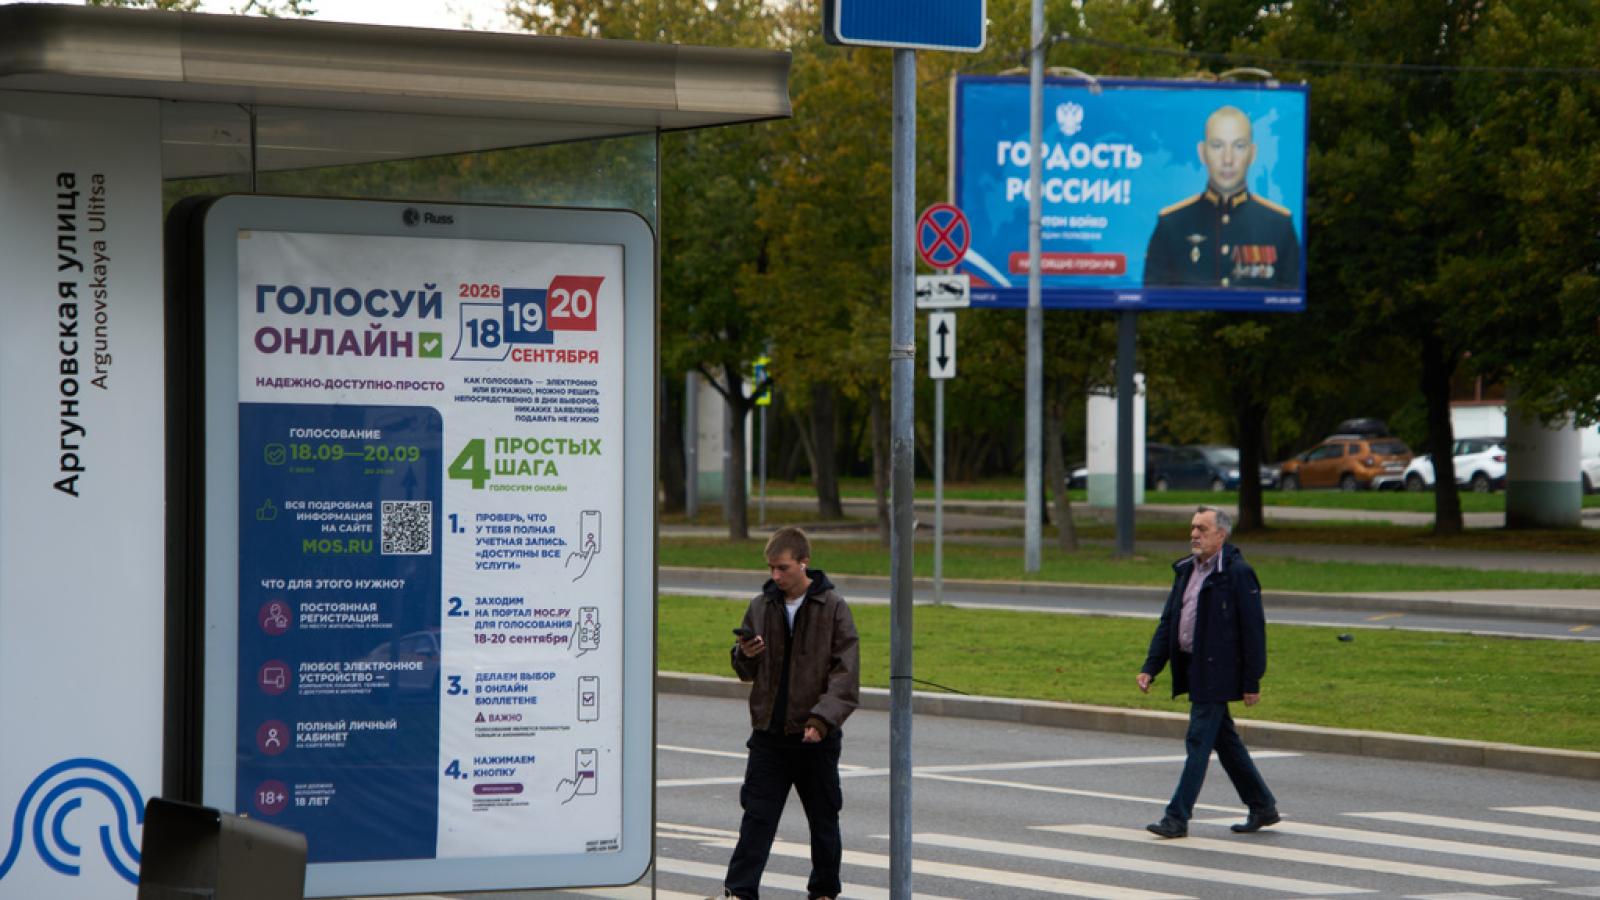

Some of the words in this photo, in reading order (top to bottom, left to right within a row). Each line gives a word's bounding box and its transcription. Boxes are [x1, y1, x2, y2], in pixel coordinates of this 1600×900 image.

[88, 173, 107, 233] Ulitsa
[57, 171, 84, 272] улица
[424, 211, 454, 225] Russ
[459, 283, 500, 299] 2026
[256, 283, 443, 319] ГОЛОСУЙ
[551, 288, 593, 318] 20
[89, 240, 112, 390] Argunovskaya
[508, 303, 543, 332] 19
[466, 318, 501, 348] 18
[254, 323, 413, 358] ОНЛАЙН
[511, 348, 599, 364] СЕНТЯБРЯ
[464, 377, 480, 385] КАК
[482, 377, 533, 385] ГОЛОСОВАТЬ
[54, 282, 86, 498] Аргуновская
[491, 387, 534, 395] БУМАЖНО,
[567, 388, 599, 396] РЕШИТЬ
[454, 395, 533, 404] НЕПОСРЕДСТВЕННО
[559, 397, 599, 406] ВЫБОРОВ,
[514, 405, 551, 413] НИКАКИХ
[554, 405, 599, 414] ЗАЯВЛЕНИЙ
[515, 415, 556, 423] ПОДАВАТЬ
[558, 415, 568, 423] НЕ
[570, 416, 599, 424] НУЖНО
[290, 428, 381, 440] ГОЛОСОВАНИЕ
[495, 437, 602, 455] ПРОСТЫХ
[447, 438, 491, 490] 4
[494, 459, 558, 476] ШАГА
[489, 484, 533, 492] ГОЛОСУЕМ
[534, 484, 567, 492] ОНЛАЙН
[285, 501, 305, 510] ВСЯ
[308, 501, 373, 511] ПОДРОБНАЯ
[297, 512, 373, 523] ИНФОРМАЦИЯ
[448, 513, 465, 533] 1.
[475, 513, 525, 523] ПРОВЕРЬ,
[527, 514, 547, 522] ЧТО
[322, 524, 337, 533] НА
[339, 522, 373, 533] САЙТЕ
[475, 526, 482, 534] У
[486, 526, 512, 534] ТЕБЯ
[513, 526, 555, 534] ПОЛНАЯ
[303, 539, 373, 554] MOS.RU
[475, 538, 523, 546] УЧЕТНАЯ
[525, 538, 567, 546] ЗАПИСЬ.
[475, 550, 539, 559] «ДОСТУПНЫ
[542, 550, 561, 558] ВСЕ
[475, 562, 521, 570] УСЛУГИ»
[261, 580, 285, 589] ЧТО
[287, 580, 312, 590] ДЛЯ
[315, 580, 353, 589] ЭТОГО
[356, 580, 405, 590] НУЖНО?
[448, 597, 469, 617] 2.
[475, 597, 524, 606] ЗАХОДИМ
[300, 603, 377, 612] ПОСТОЯННАЯ
[475, 609, 489, 617] НА
[492, 609, 531, 617] ПОРТАЛ
[534, 609, 570, 617] МОС.РУ
[300, 613, 379, 624] РЕГИСТРАЦИЯ
[475, 621, 496, 630] ДЛЯ
[498, 620, 572, 629] ГОЛОСОВАНИЯ
[475, 634, 506, 644] 18-20
[509, 634, 568, 645] сентября
[299, 661, 340, 671] ЛЮБОЕ
[344, 661, 423, 671] ЭЛЕКТРОННОЕ
[299, 672, 372, 682] УСТРОЙСТВО
[475, 673, 518, 682] ДЕЛАЕМ
[520, 672, 556, 681] ВЫБОР
[447, 676, 468, 695] 3.
[484, 684, 528, 693] ОНЛАЙН
[475, 696, 537, 705] БЮЛЛЕТЕНЕ
[489, 714, 522, 722] ВАЖНО
[297, 720, 345, 731] ПОЛНЫЙ
[349, 718, 397, 730] ЛИЧНЫЙ
[297, 732, 348, 742] КАБИНЕТ
[473, 755, 535, 765] НАЖИМАЕМ
[444, 759, 468, 780] 4.
[473, 768, 517, 777] КНОПКУ
[259, 791, 284, 805] 18+
[295, 798, 305, 806] 18
[308, 797, 330, 806] ЛЕТ
